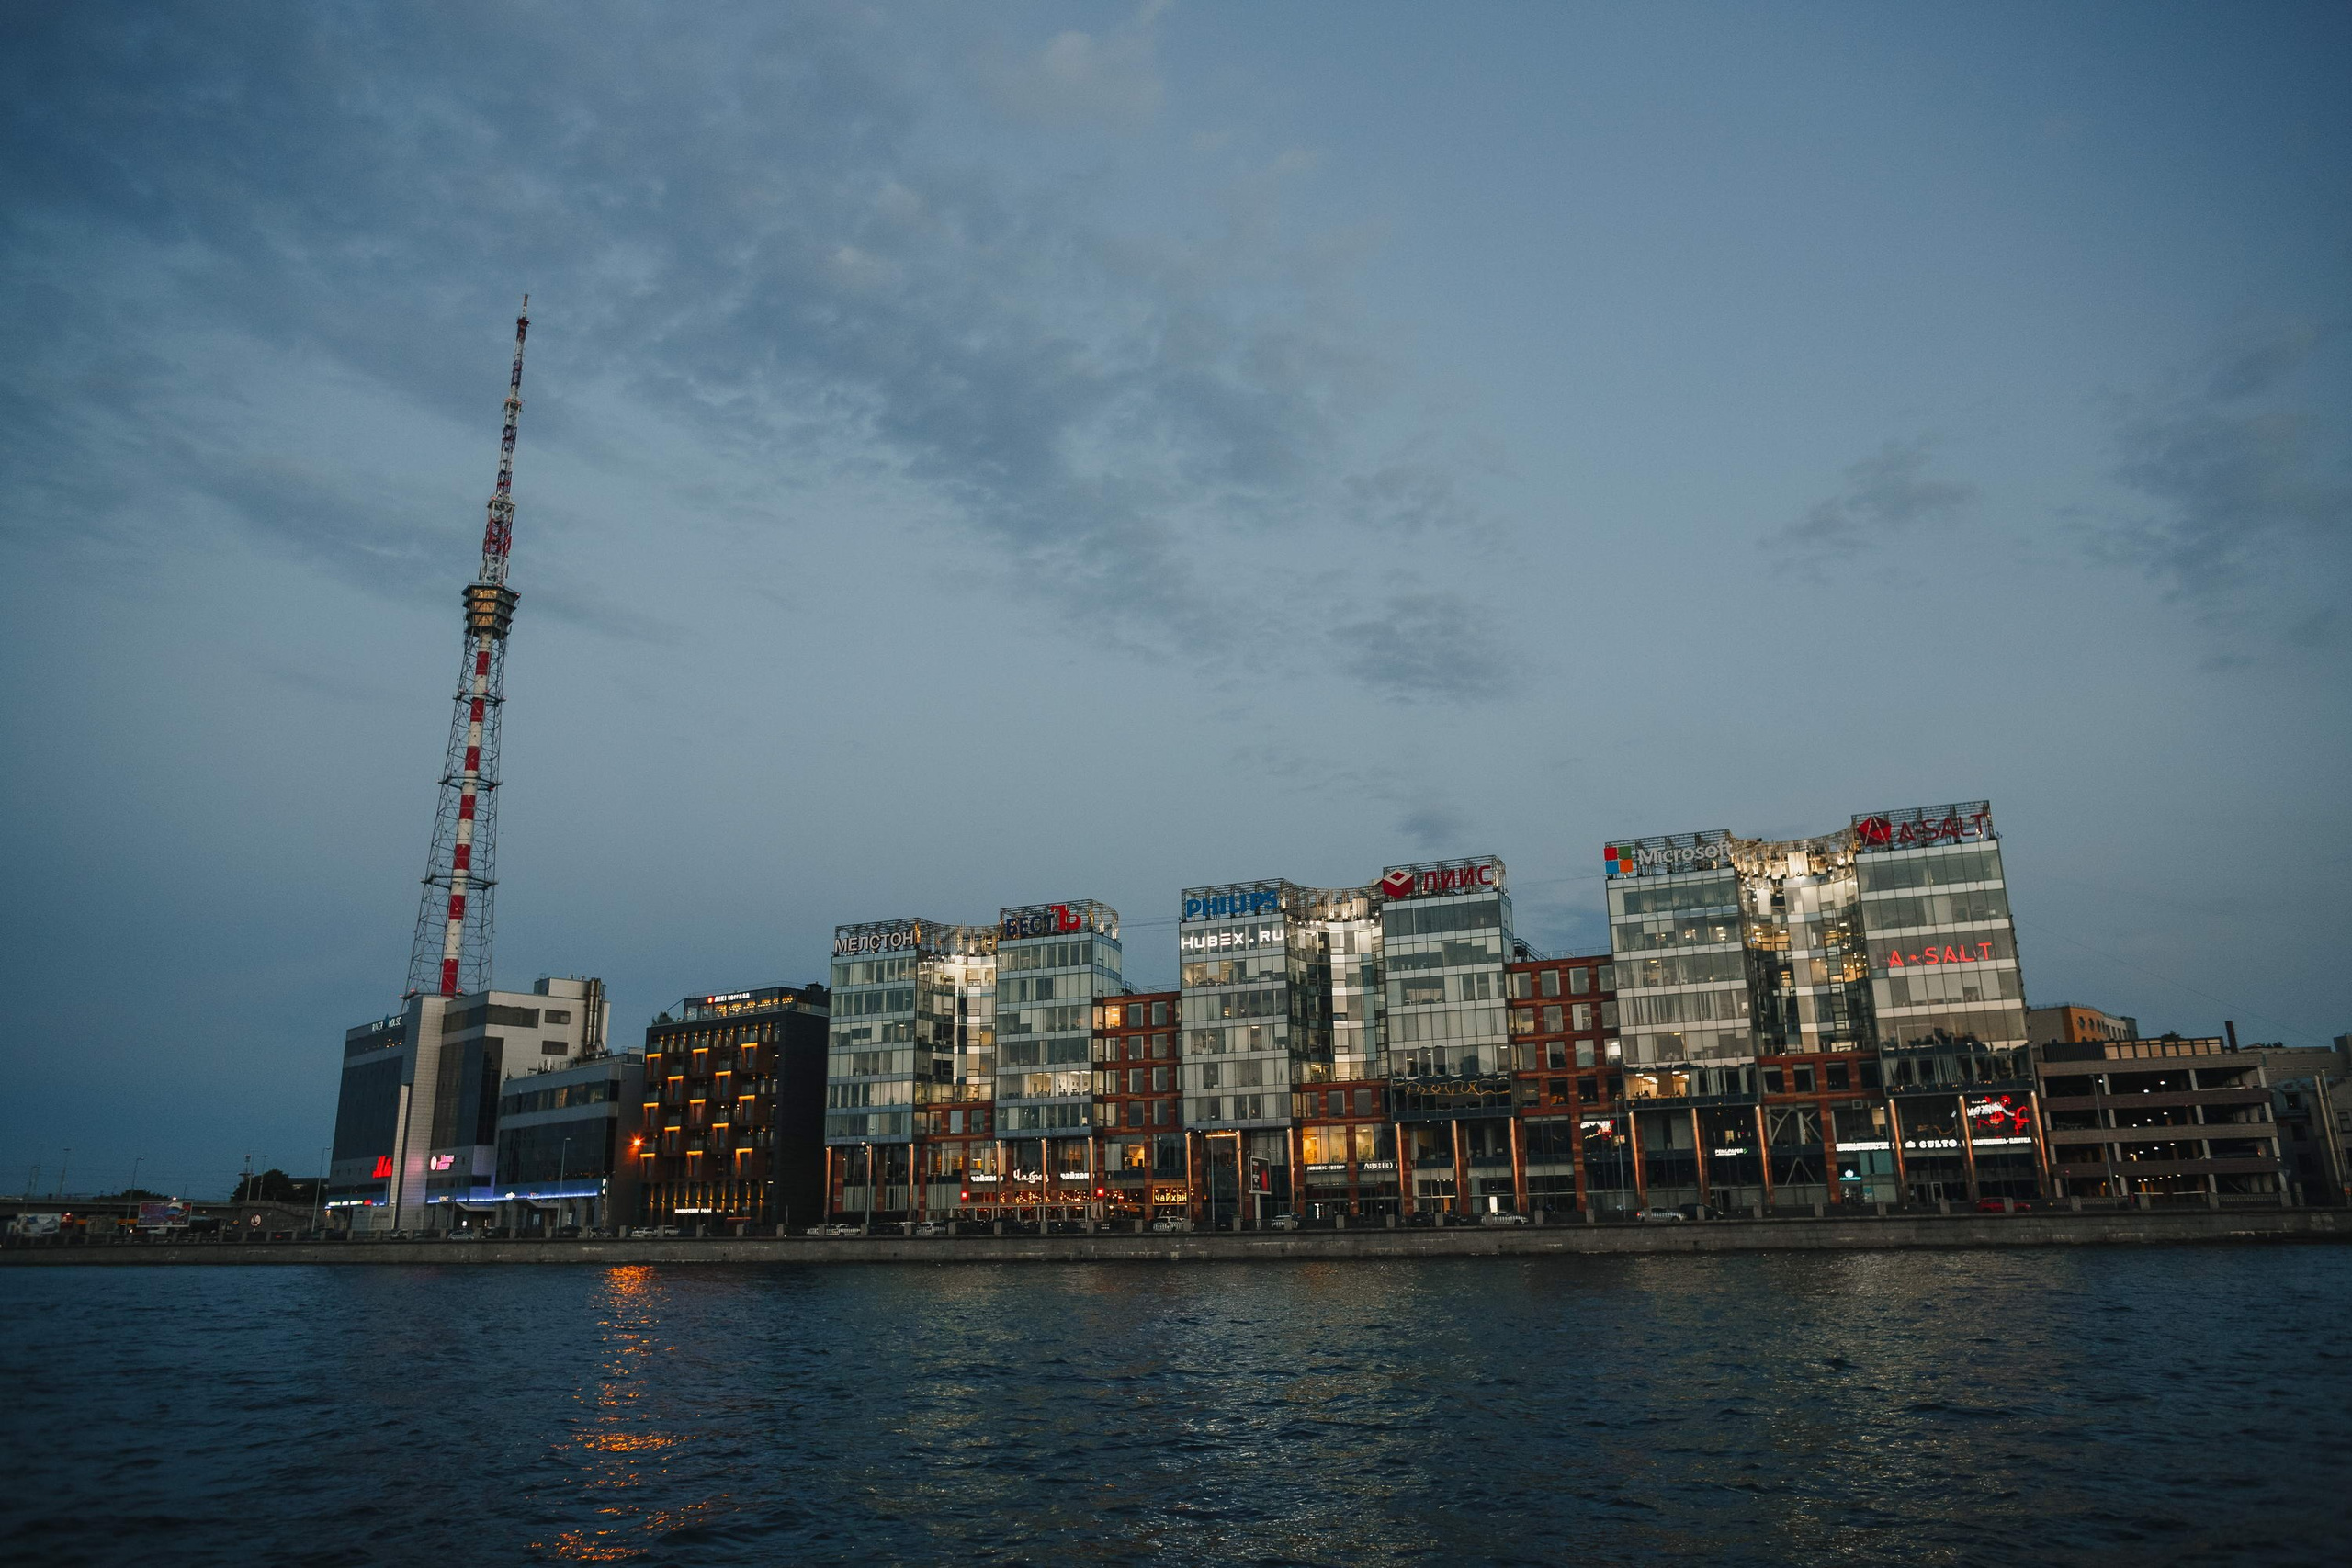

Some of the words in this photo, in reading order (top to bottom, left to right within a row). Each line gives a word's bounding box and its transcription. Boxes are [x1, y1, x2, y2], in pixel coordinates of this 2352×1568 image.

[1637, 840, 1733, 864] Microsoft
[1186, 890, 1278, 917] PHILIPS
[834, 931, 914, 953] МЕЛСТОН
[1181, 929, 1284, 950] HUBEX.RU
[1060, 1171, 1095, 1180] чайхан
[1155, 1192, 1188, 1202] чайхан
